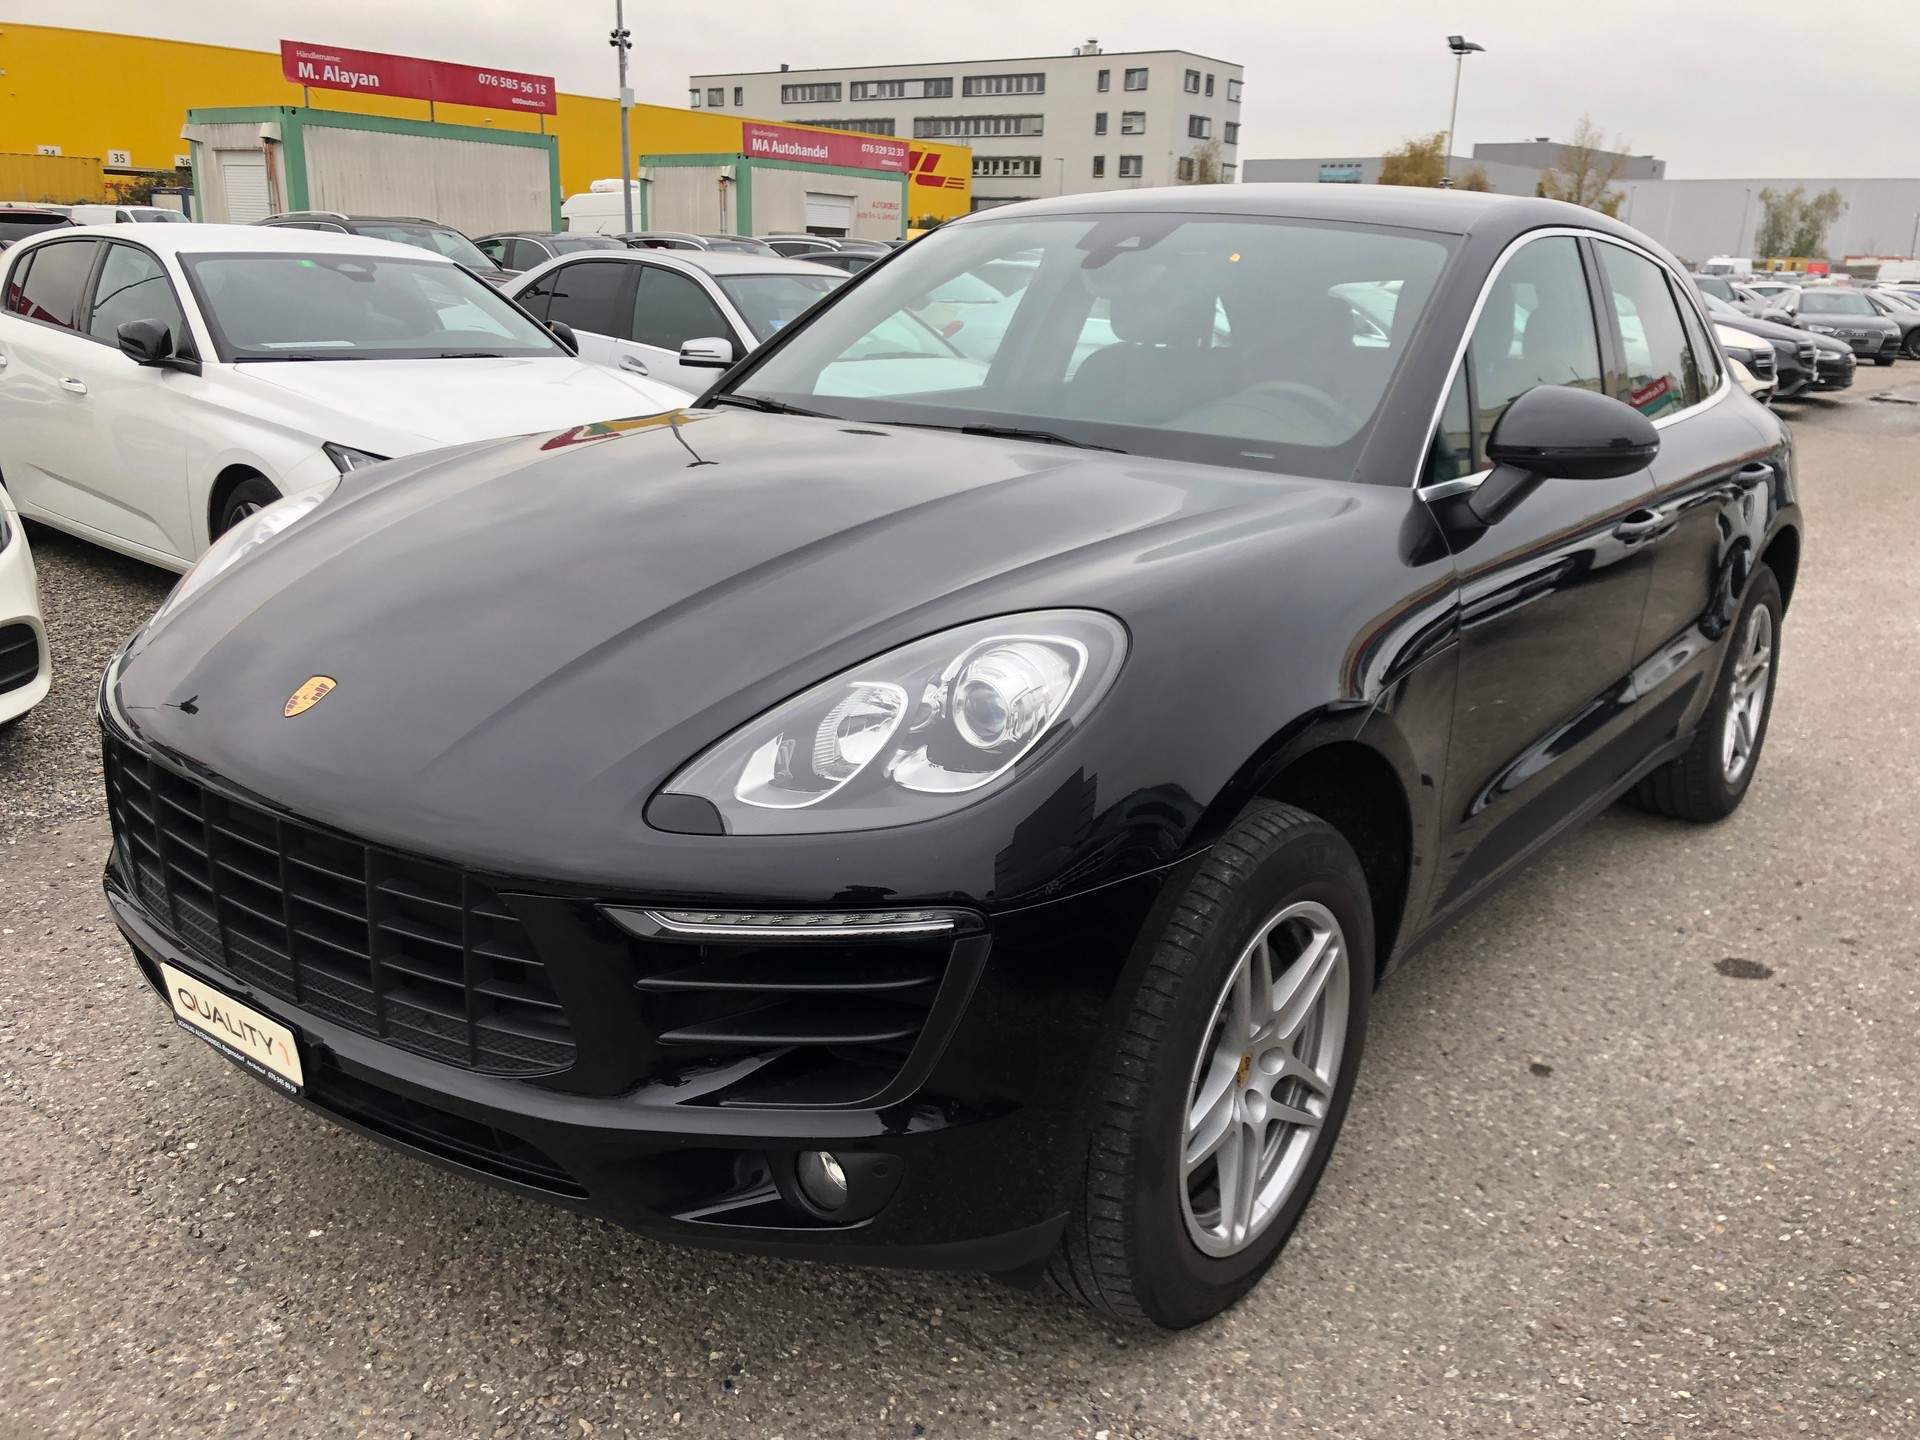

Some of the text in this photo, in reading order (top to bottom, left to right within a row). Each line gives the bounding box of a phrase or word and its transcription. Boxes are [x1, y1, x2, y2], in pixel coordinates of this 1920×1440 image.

[296, 50, 342, 62] Händlername:
[298, 62, 379, 88] M. Alayan
[478, 73, 548, 95] 076 585 56 15
[752, 138, 829, 158] MA Autohandel
[861, 143, 874, 153] 076
[887, 146, 896, 156] 32
[896, 148, 905, 157] 33
[113, 153, 126, 164] 35
[177, 987, 273, 1055] QUALITY
